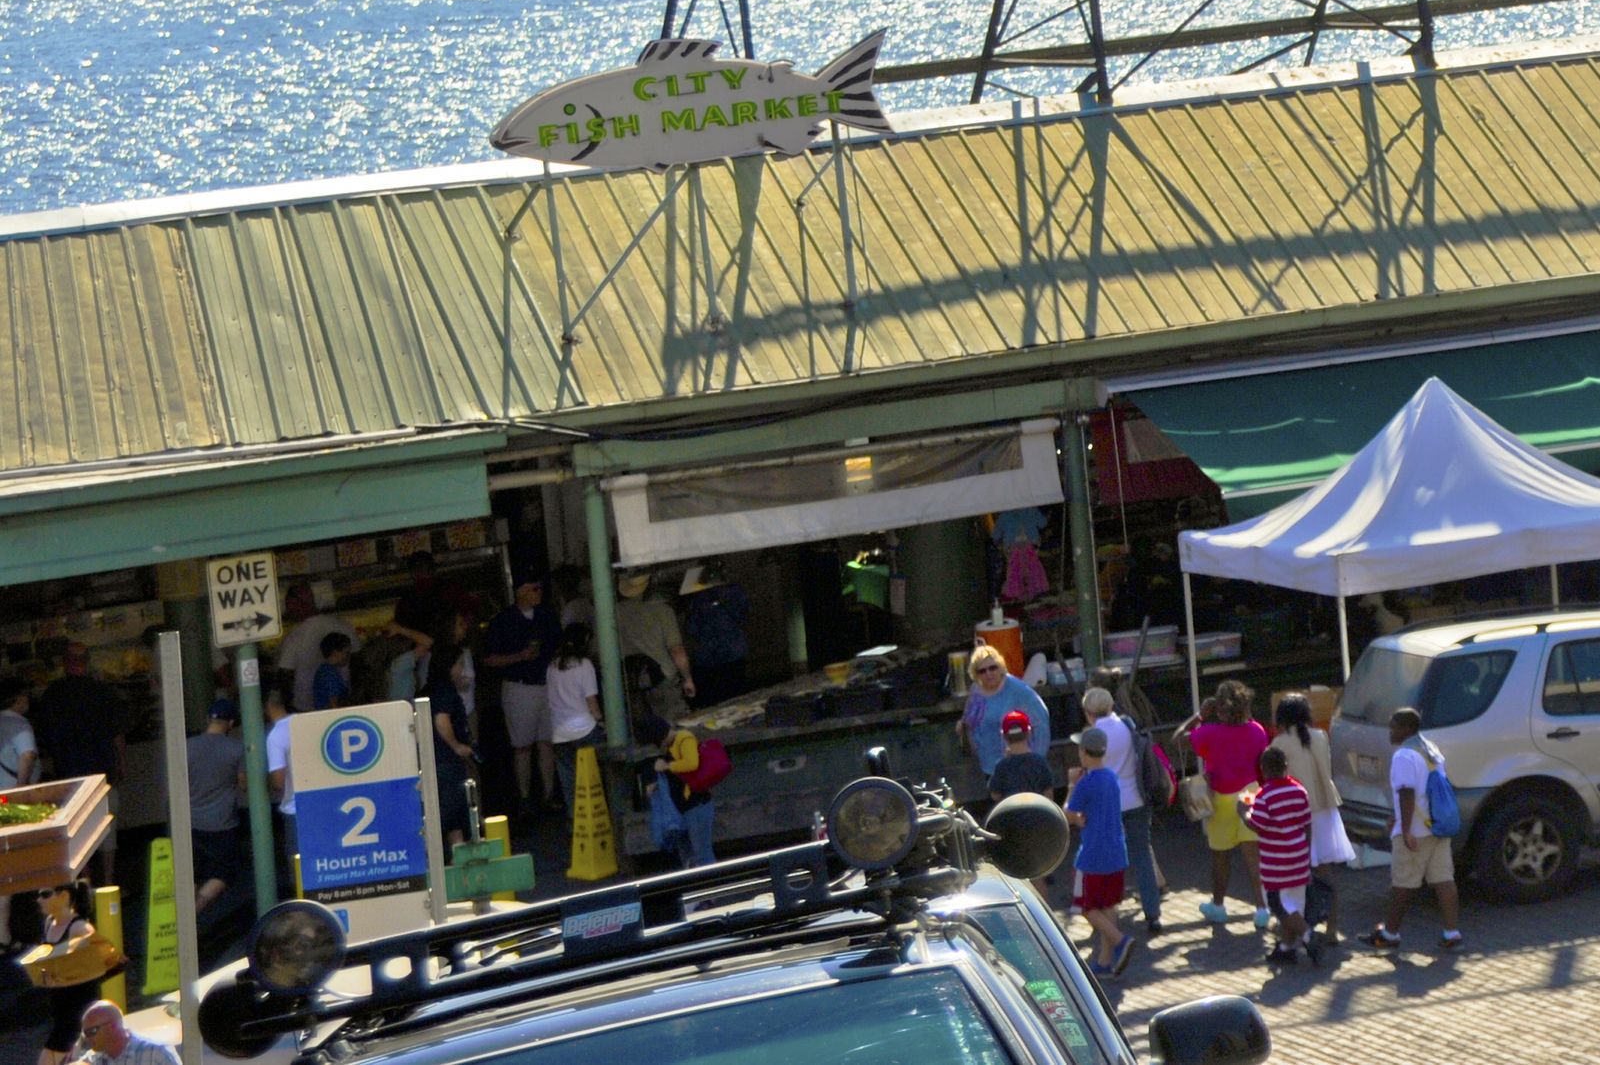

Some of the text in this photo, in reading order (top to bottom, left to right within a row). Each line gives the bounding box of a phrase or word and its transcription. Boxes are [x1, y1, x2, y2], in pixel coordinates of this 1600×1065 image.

[633, 66, 749, 101] CITY
[538, 89, 845, 148] FISH MARKET
[216, 560, 268, 585] ONE
[217, 583, 270, 610] WAY
[341, 729, 368, 763] P
[340, 797, 379, 847] 2
[315, 849, 408, 872] Hours Max
[324, 872, 349, 882] Hours
[350, 868, 366, 879] Max
[367, 865, 389, 876] After
[318, 891, 333, 901] Pay
